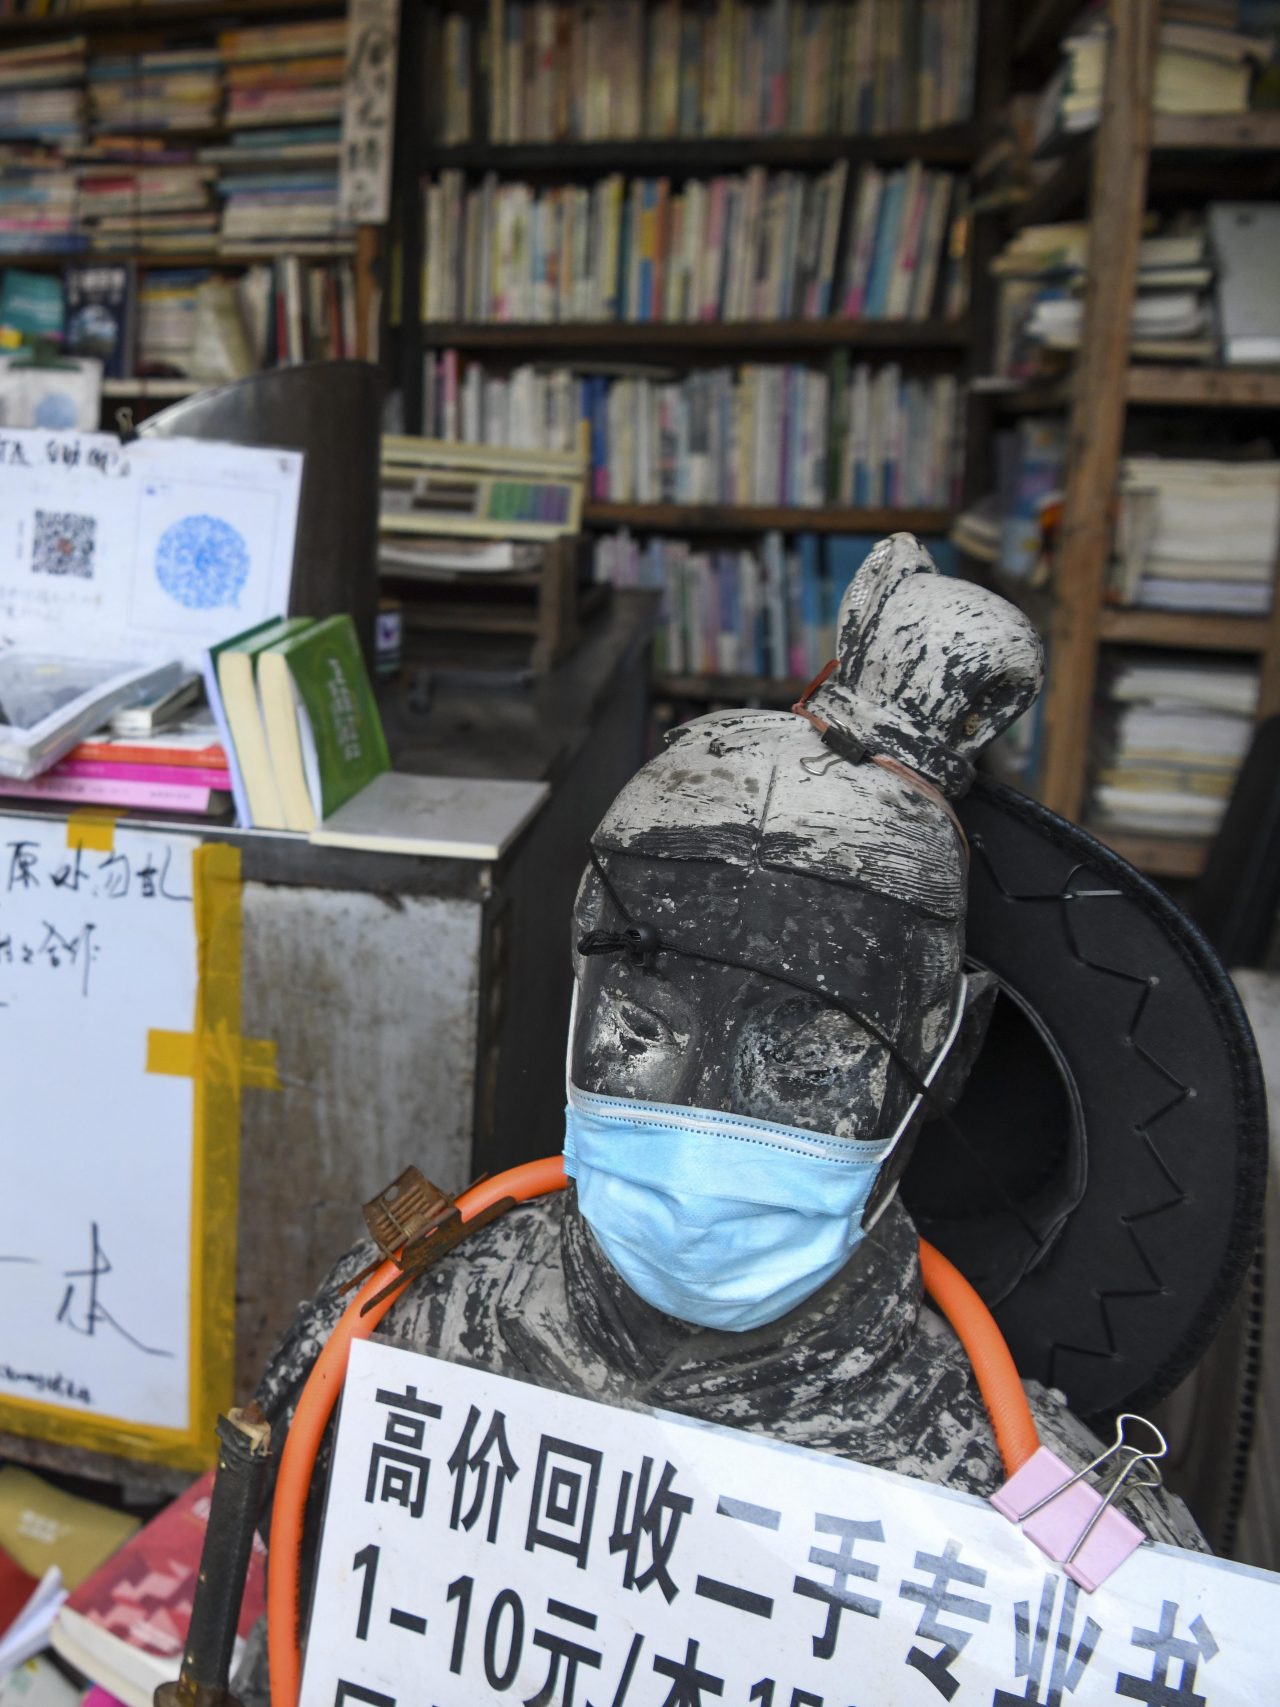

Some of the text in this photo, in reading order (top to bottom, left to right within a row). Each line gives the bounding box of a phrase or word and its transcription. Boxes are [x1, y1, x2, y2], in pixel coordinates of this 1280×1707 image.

[364, 1385, 1222, 1707] 高价回收二手专业书
